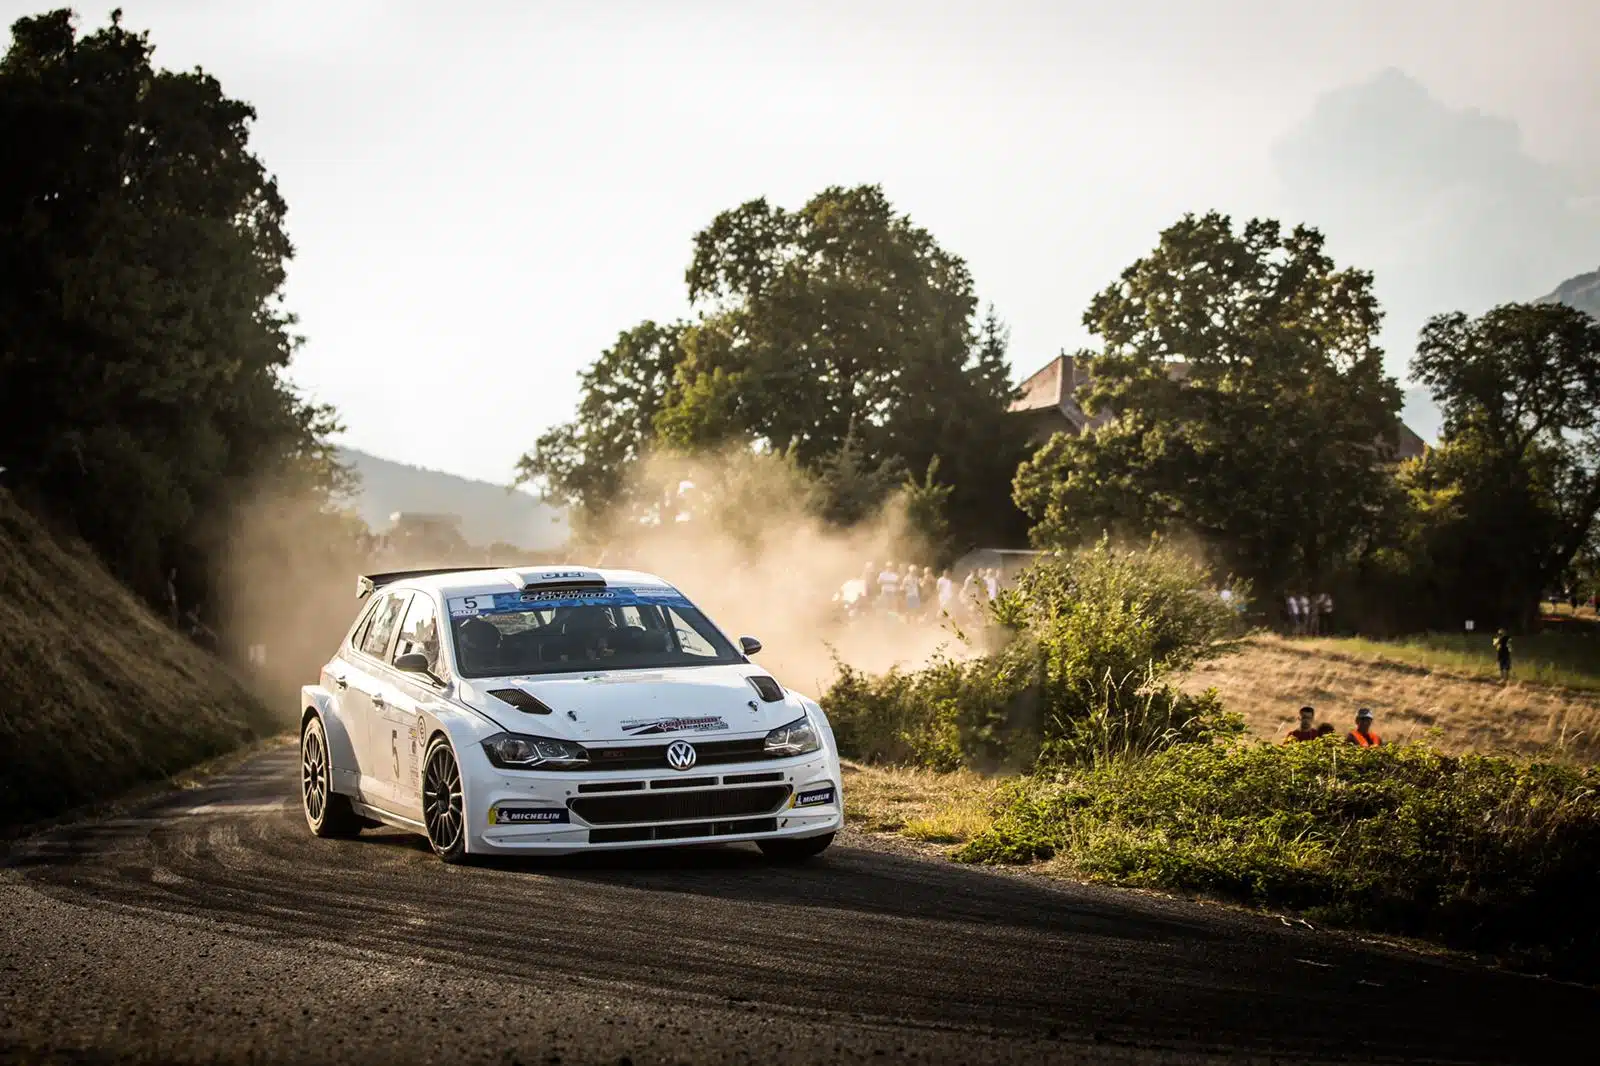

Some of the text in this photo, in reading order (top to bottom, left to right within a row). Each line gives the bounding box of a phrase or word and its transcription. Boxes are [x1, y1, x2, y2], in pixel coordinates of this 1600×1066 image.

[463, 597, 478, 609] 5
[391, 729, 400, 779] 5
[667, 740, 697, 771] VW
[802, 793, 830, 803] MICHELIN
